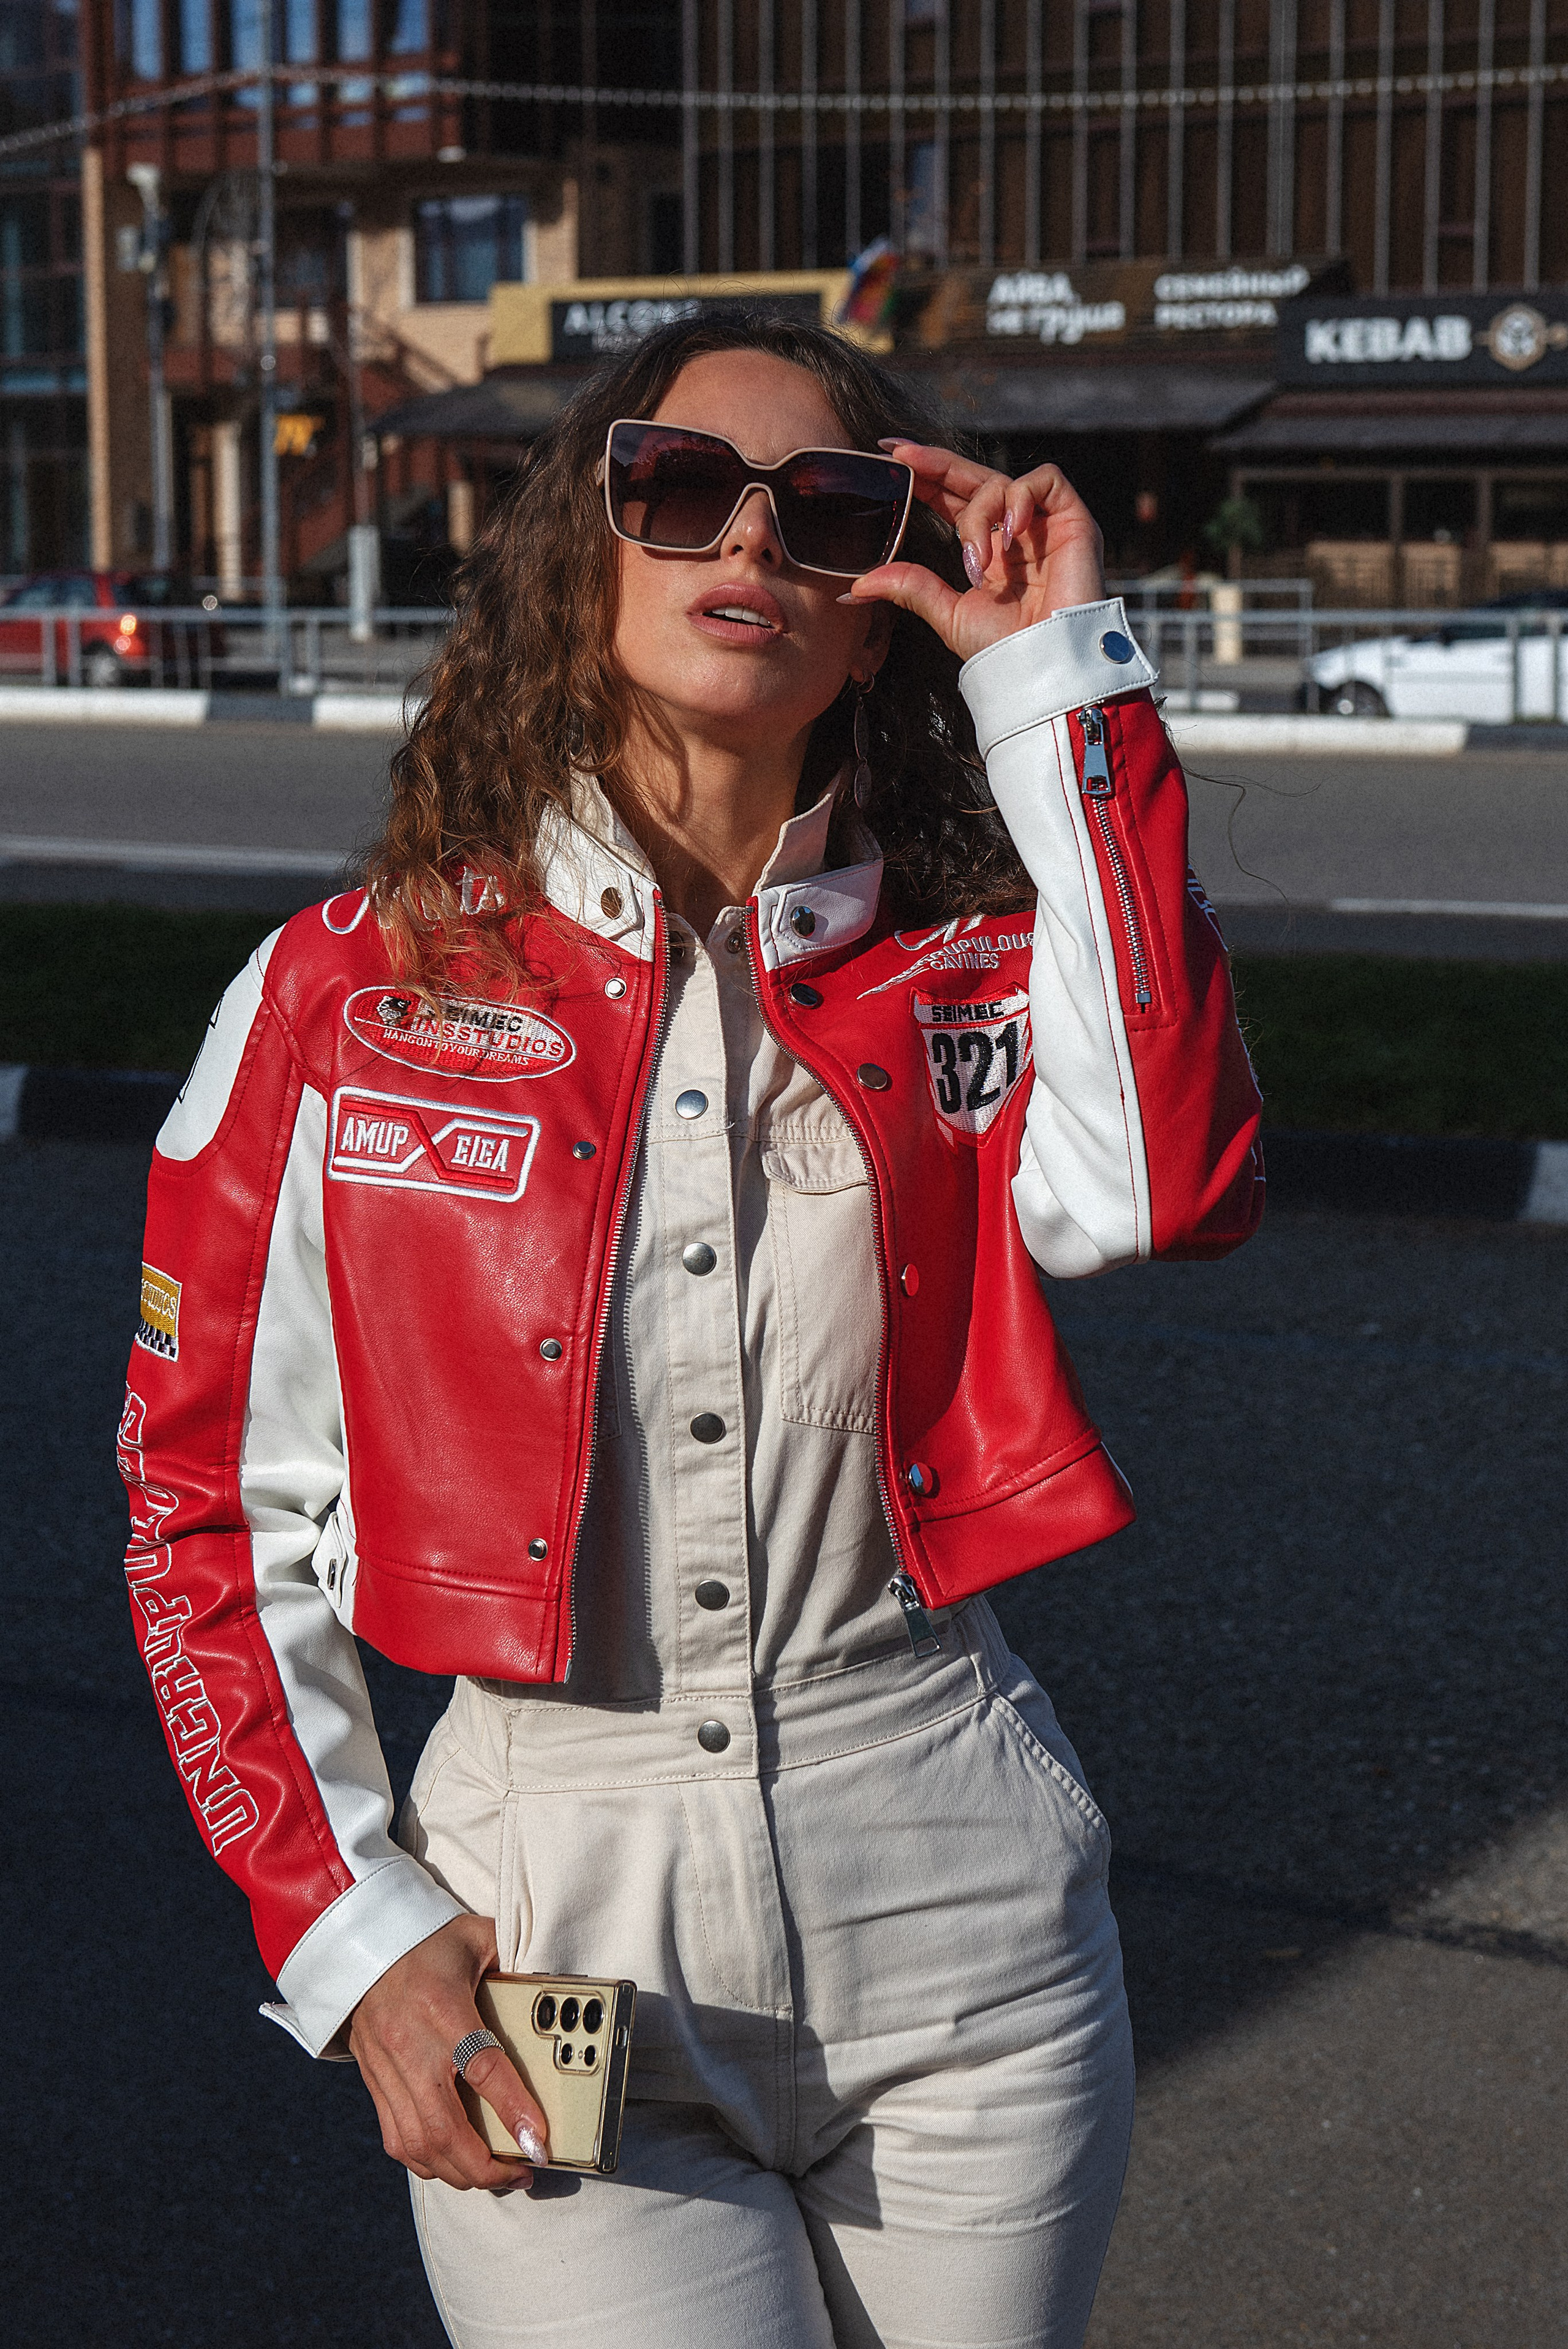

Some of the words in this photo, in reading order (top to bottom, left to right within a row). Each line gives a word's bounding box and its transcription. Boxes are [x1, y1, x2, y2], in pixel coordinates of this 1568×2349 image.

[1155, 301, 1278, 330] РЕСТОРА
[1305, 315, 1472, 363] KEBAB
[427, 1001, 522, 1032] EIMEC
[932, 1001, 1005, 1023] SEIMEC
[932, 1021, 1019, 1114] 321
[340, 1117, 409, 1157] AMUP
